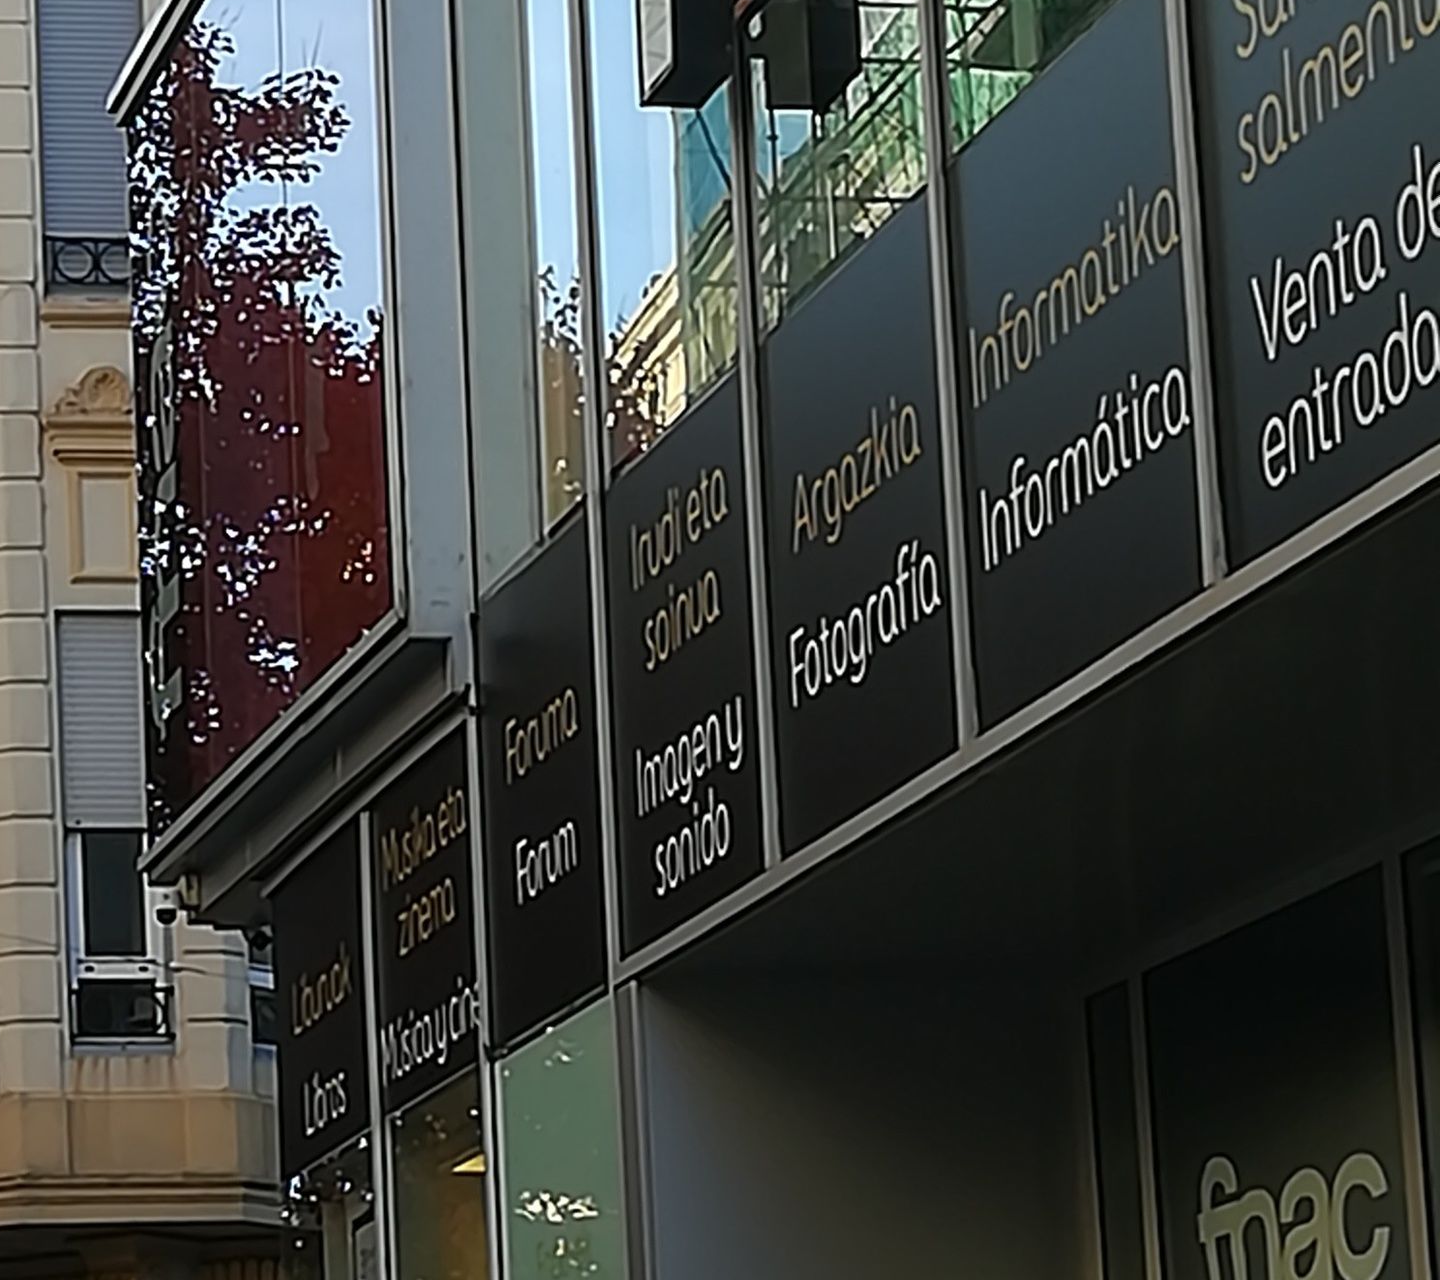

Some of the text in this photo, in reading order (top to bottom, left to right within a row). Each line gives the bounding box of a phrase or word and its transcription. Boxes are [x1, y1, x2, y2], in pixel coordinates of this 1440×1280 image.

[968, 184, 1180, 409] Informatika
[1250, 215, 1387, 362] Venta
[629, 466, 730, 592] Irudi eta
[793, 395, 922, 554] Argazkia
[979, 366, 1191, 571] Informática
[644, 569, 721, 671] soinua
[787, 539, 942, 708] Fotografía
[504, 687, 579, 786] Foruma
[634, 695, 744, 818] Imagen y
[514, 820, 578, 907] Forum
[655, 787, 730, 896] sonido
